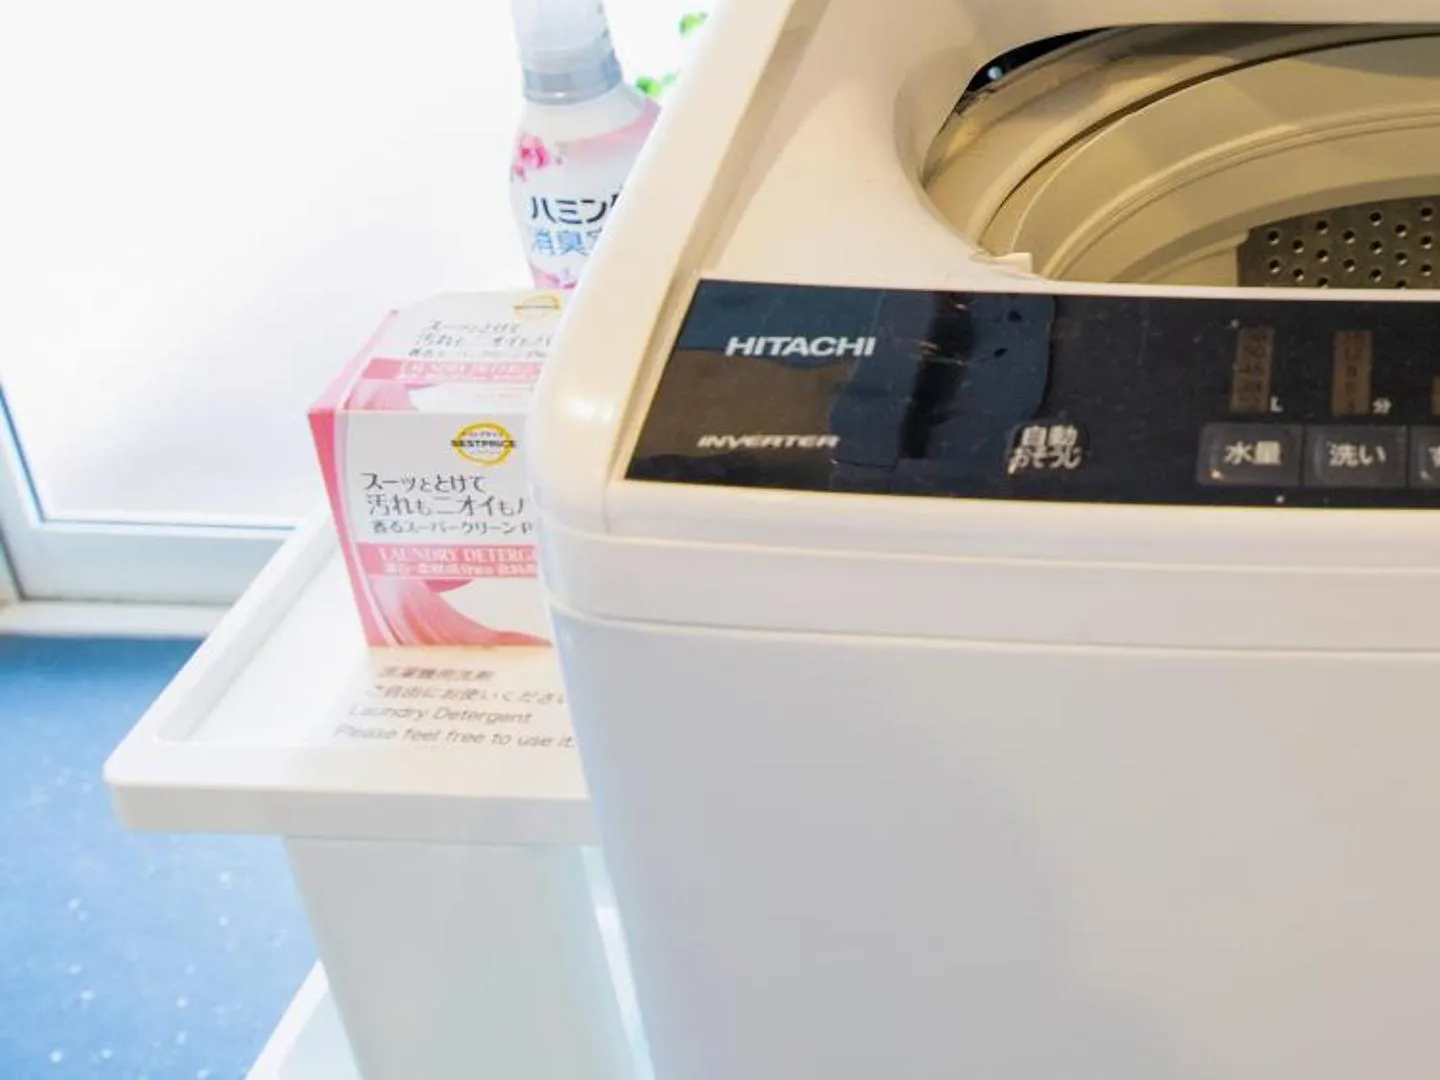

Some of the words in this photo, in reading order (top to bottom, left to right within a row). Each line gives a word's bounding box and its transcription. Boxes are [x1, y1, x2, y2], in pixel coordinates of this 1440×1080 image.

[725, 336, 876, 358] HITACHI
[1371, 397, 1393, 414] 分
[695, 433, 841, 450] INVERTER
[1020, 425, 1079, 448] 自動
[1008, 446, 1084, 473] おそうじ
[1224, 442, 1282, 466] 水量
[1328, 442, 1387, 467] 洗い
[349, 703, 427, 721] Laundry
[432, 705, 537, 725] Detergent
[403, 728, 442, 742] feel
[444, 729, 485, 744] free
[491, 732, 513, 746] to
[517, 736, 554, 747] use
